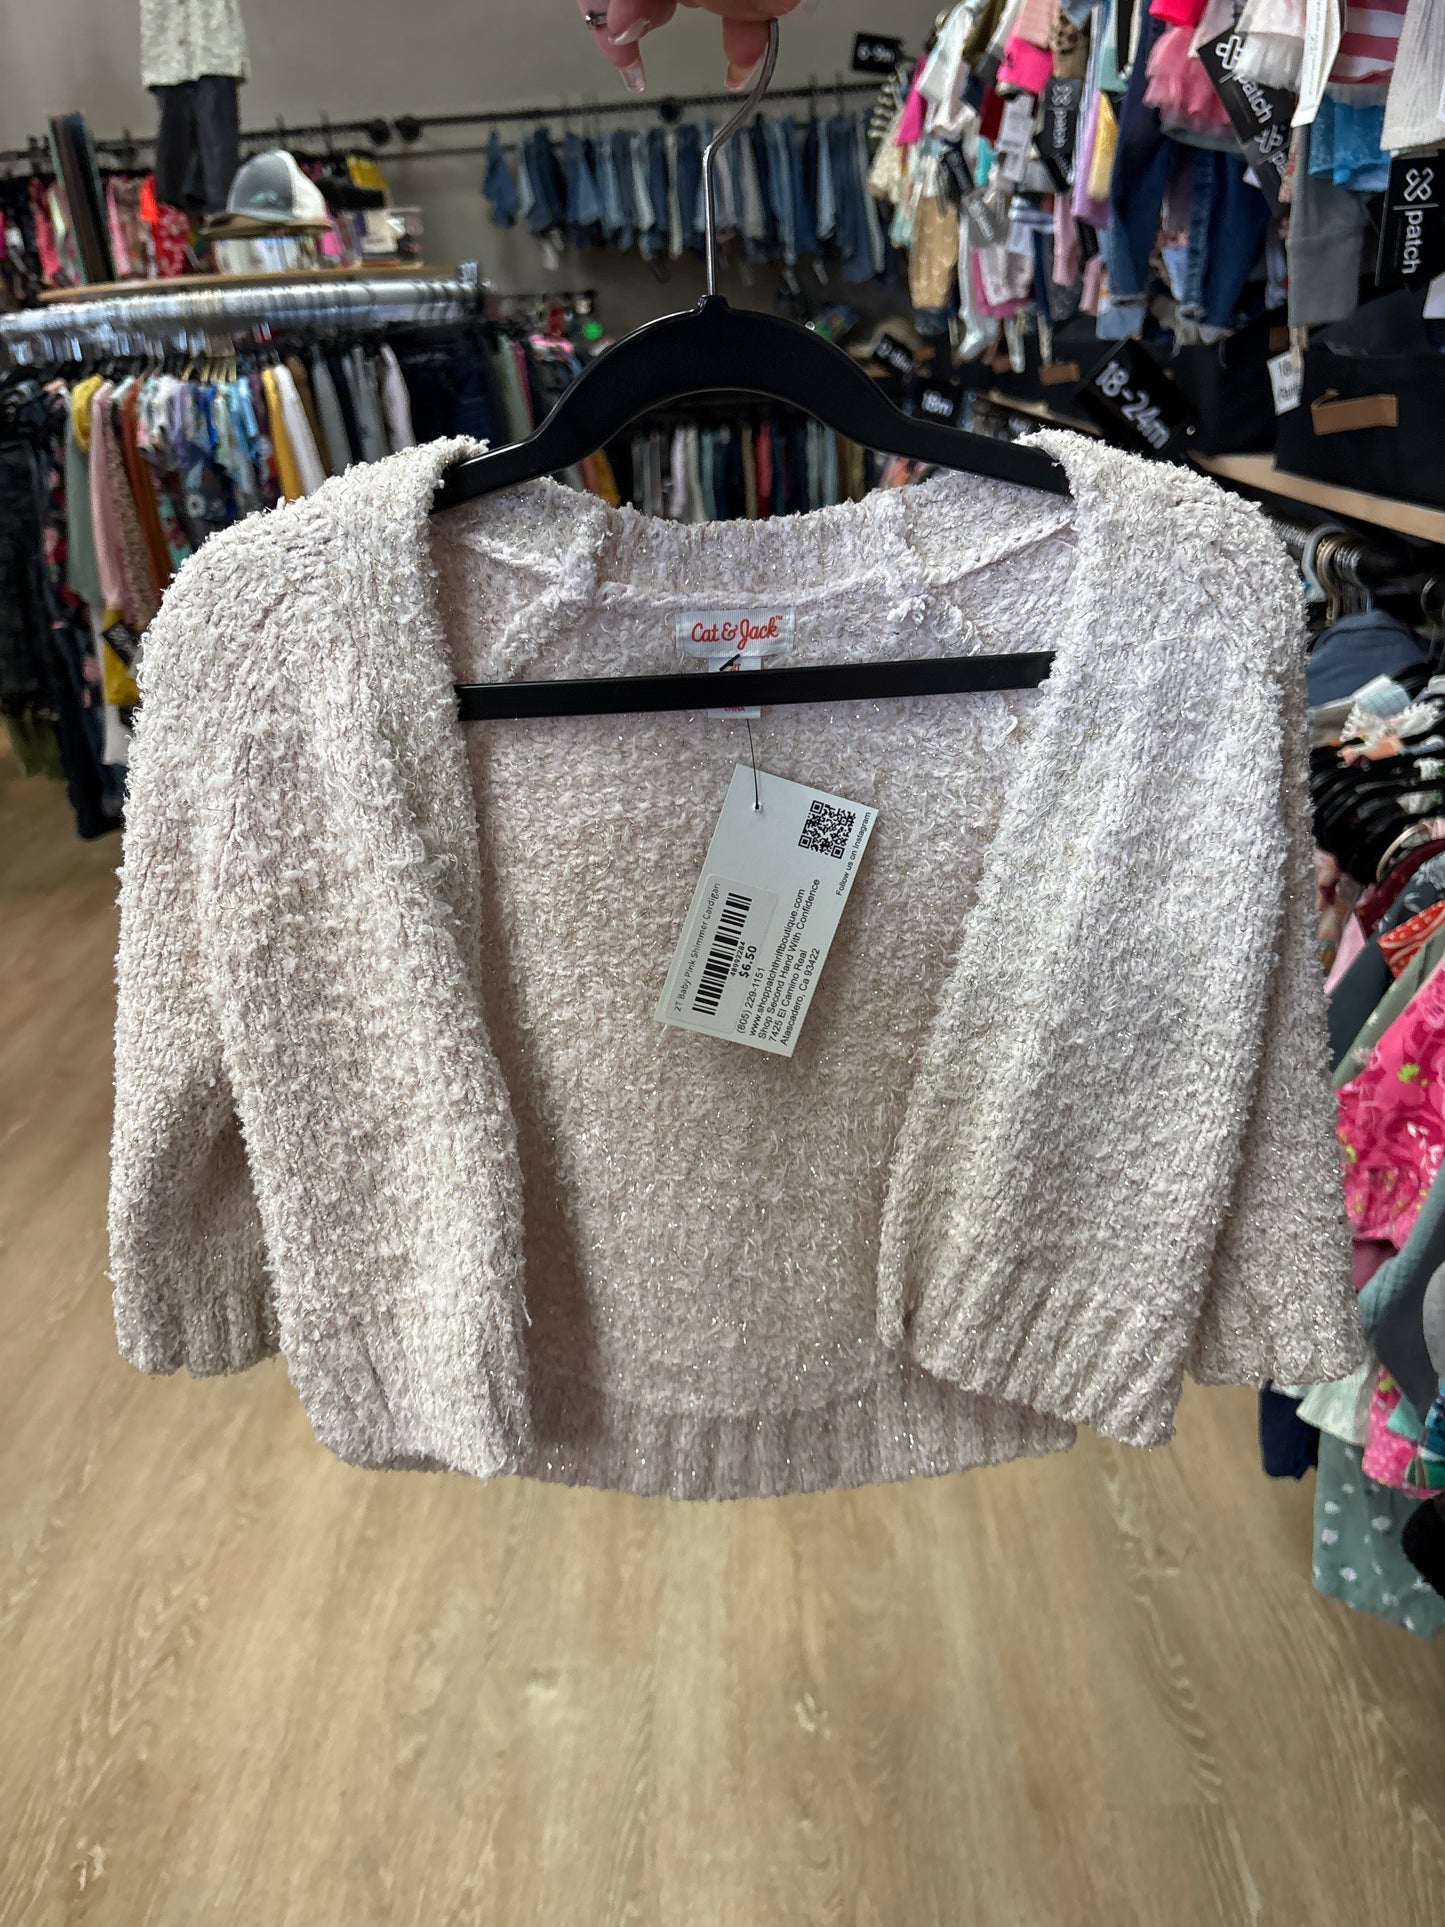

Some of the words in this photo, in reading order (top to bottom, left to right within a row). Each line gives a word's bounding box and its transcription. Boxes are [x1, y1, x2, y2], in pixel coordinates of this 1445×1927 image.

[1401, 209, 1424, 274] patch
[1095, 361, 1170, 449] 18-24m
[691, 622, 719, 642] Cat
[721, 622, 738, 641] &
[853, 811, 871, 849] Instagram
[846, 861, 853, 871] us
[850, 850, 857, 860] on
[836, 872, 849, 896] Follow
[703, 882, 720, 920] Cardigan
[691, 921, 708, 959] Shimmer
[685, 959, 697, 978] Pink
[738, 945, 757, 978] $6.50
[749, 889, 805, 1036] www.shoppatchthriftboutique.com
[758, 1016, 772, 1040] Shop
[767, 980, 784, 1014] Second
[779, 953, 794, 979] Hand
[788, 932, 801, 952] With
[796, 879, 820, 930] Confidence
[794, 949, 807, 971] Real
[804, 947, 820, 975] 93422
[677, 978, 691, 999] Baby
[781, 972, 799, 1007] Camino
[799, 977, 810, 992] Ca
[673, 1000, 684, 1012] 2T
[736, 1010, 752, 1034] (805)
[745, 967, 765, 1009] 229-1151
[777, 1008, 787, 1019] El
[769, 1019, 783, 1042] 7425
[780, 994, 805, 1046] Atascadero,
